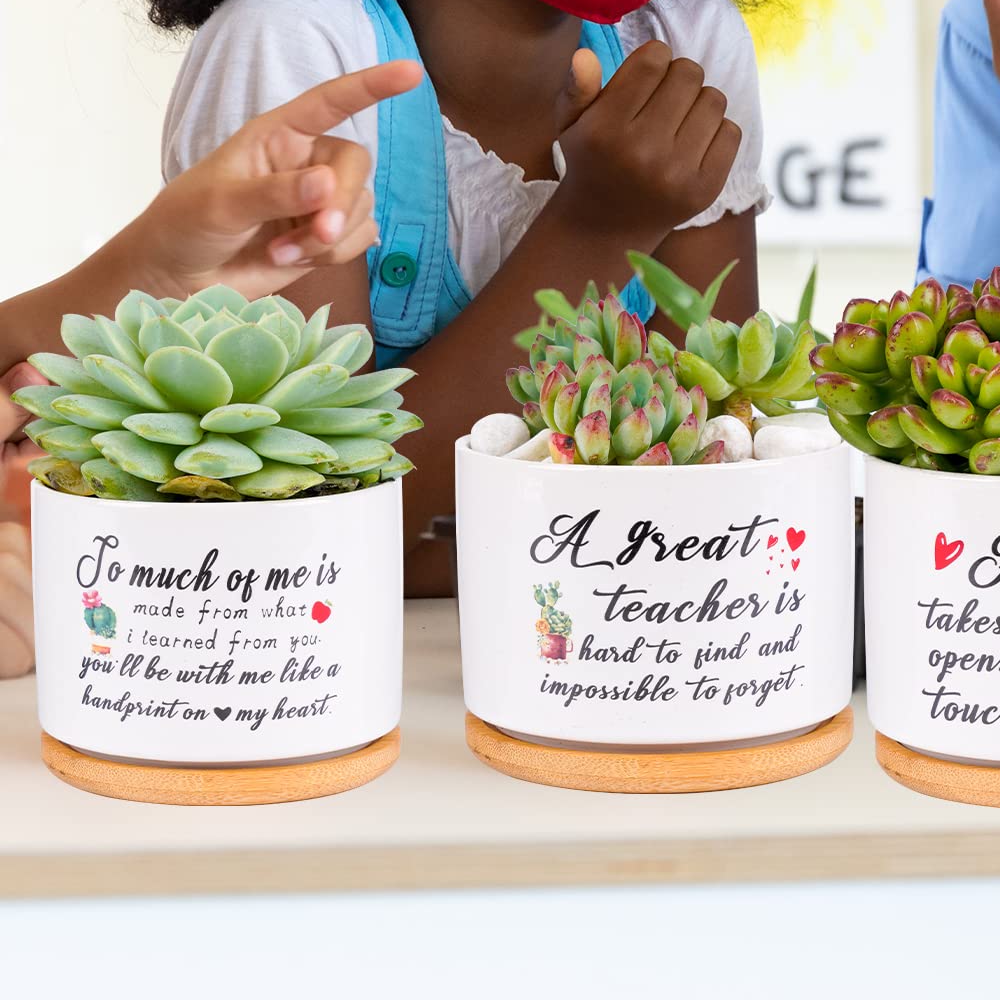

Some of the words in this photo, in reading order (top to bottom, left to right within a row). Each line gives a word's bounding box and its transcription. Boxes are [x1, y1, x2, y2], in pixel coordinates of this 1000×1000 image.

[529, 509, 615, 570] A
[615, 514, 779, 565] great
[129, 548, 219, 592] much
[227, 567, 260, 603] of
[264, 565, 312, 592] me
[316, 553, 342, 586] is
[133, 597, 185, 617] made
[198, 599, 248, 625] from
[261, 597, 308, 617] what
[592, 578, 770, 623] teacher
[774, 581, 806, 615] is
[127, 629, 134, 644] i
[142, 629, 217, 650] learned
[229, 630, 277, 655] from
[578, 632, 646, 664] hard
[645, 640, 682, 664] to
[694, 632, 751, 669] find
[758, 624, 802, 656] and
[79, 653, 144, 679] you'll
[144, 655, 172, 682] be
[176, 659, 234, 685] with
[238, 667, 275, 685] me
[279, 655, 324, 683] like
[326, 662, 342, 678] a
[539, 673, 680, 708] impossible
[685, 675, 720, 701] to
[721, 664, 806, 707] forget.
[81, 684, 189, 721] handprint
[182, 706, 210, 721] on
[235, 707, 269, 731] my
[271, 694, 338, 720] heart.
